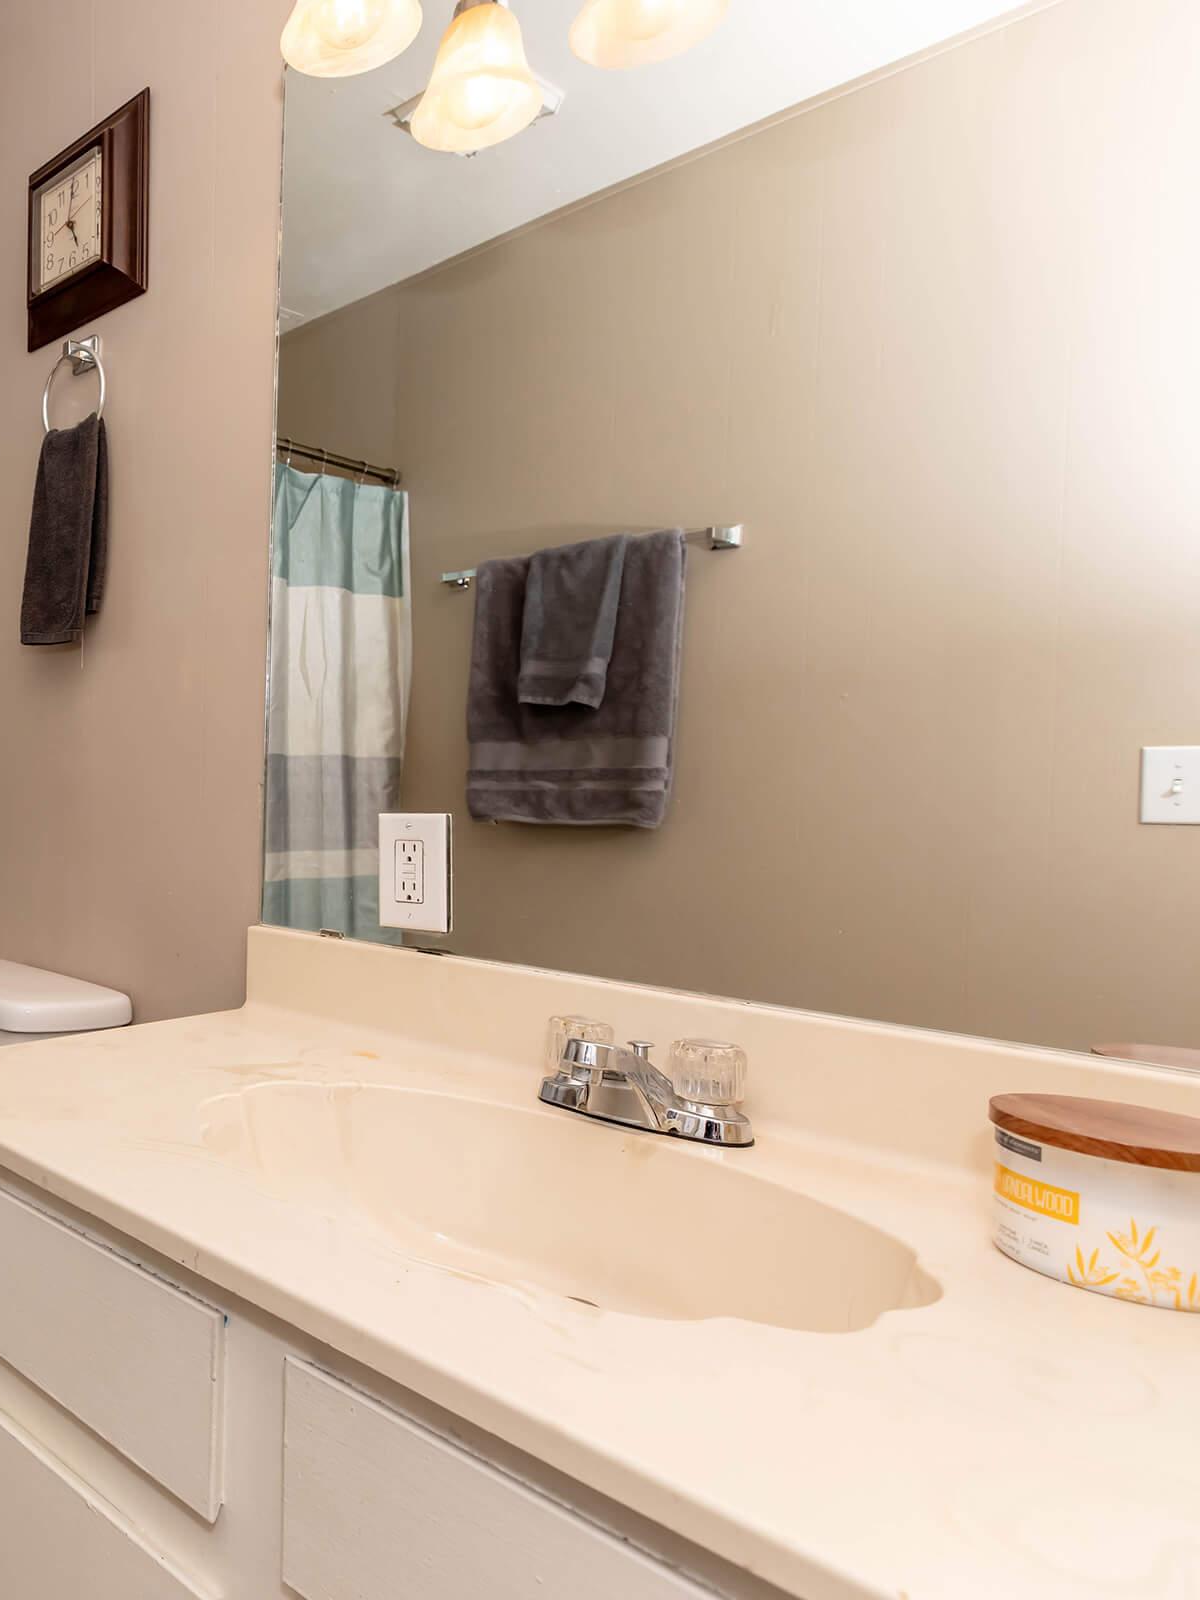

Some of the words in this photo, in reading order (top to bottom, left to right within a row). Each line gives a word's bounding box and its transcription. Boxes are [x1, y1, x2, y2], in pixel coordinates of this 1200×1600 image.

[57, 190, 65, 209] 11
[48, 208, 58, 227] 10
[46, 232, 54, 248] 9
[68, 250, 76, 267] 6
[81, 242, 89, 260] 5
[46, 253, 54, 271] 8
[57, 257, 65, 274] 7
